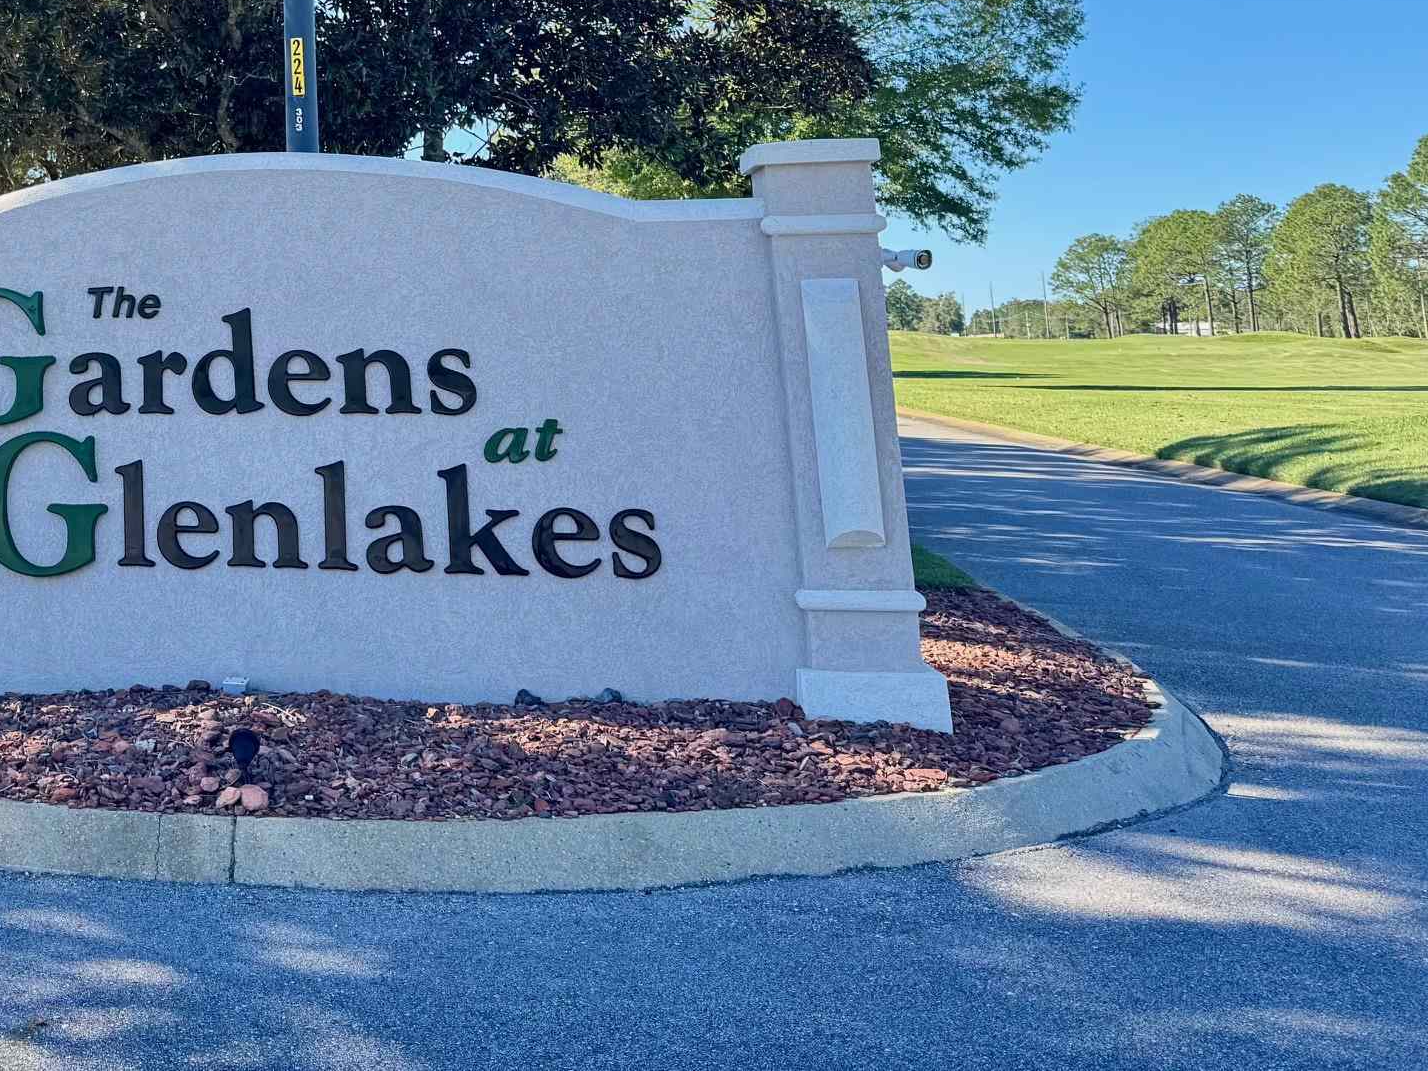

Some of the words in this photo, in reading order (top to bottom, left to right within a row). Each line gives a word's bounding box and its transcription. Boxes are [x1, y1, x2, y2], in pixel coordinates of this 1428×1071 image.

[292, 39, 303, 94] 224
[87, 286, 162, 320] The
[483, 418, 564, 464] at
